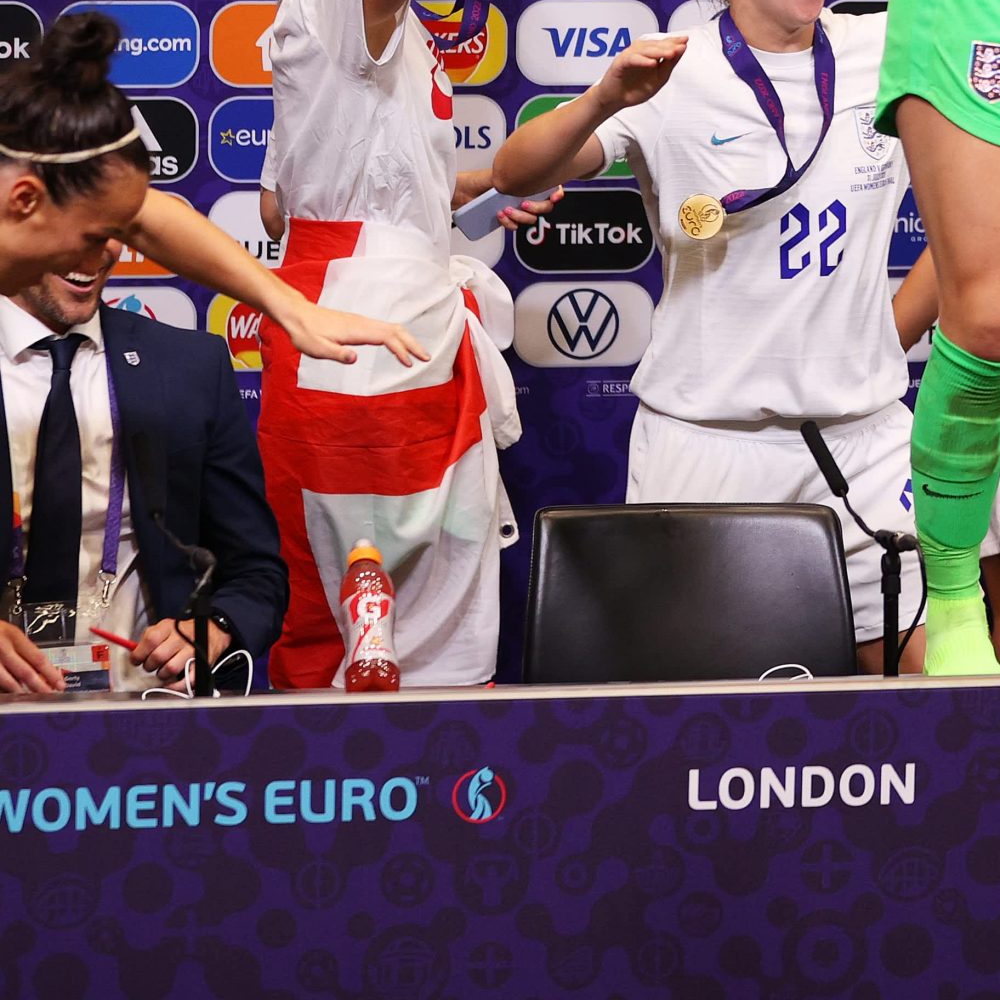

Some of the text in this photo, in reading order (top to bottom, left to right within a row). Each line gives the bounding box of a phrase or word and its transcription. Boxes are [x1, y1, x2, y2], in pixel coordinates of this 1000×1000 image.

[117, 36, 191, 56] ng.com
[542, 27, 632, 57] VISA
[555, 223, 643, 245] TikTok
[780, 199, 847, 280] 22
[239, 390, 258, 399] EFA
[687, 762, 917, 811] LONDON
[0, 781, 249, 834] WOMEN'S
[264, 777, 418, 825] EURO
